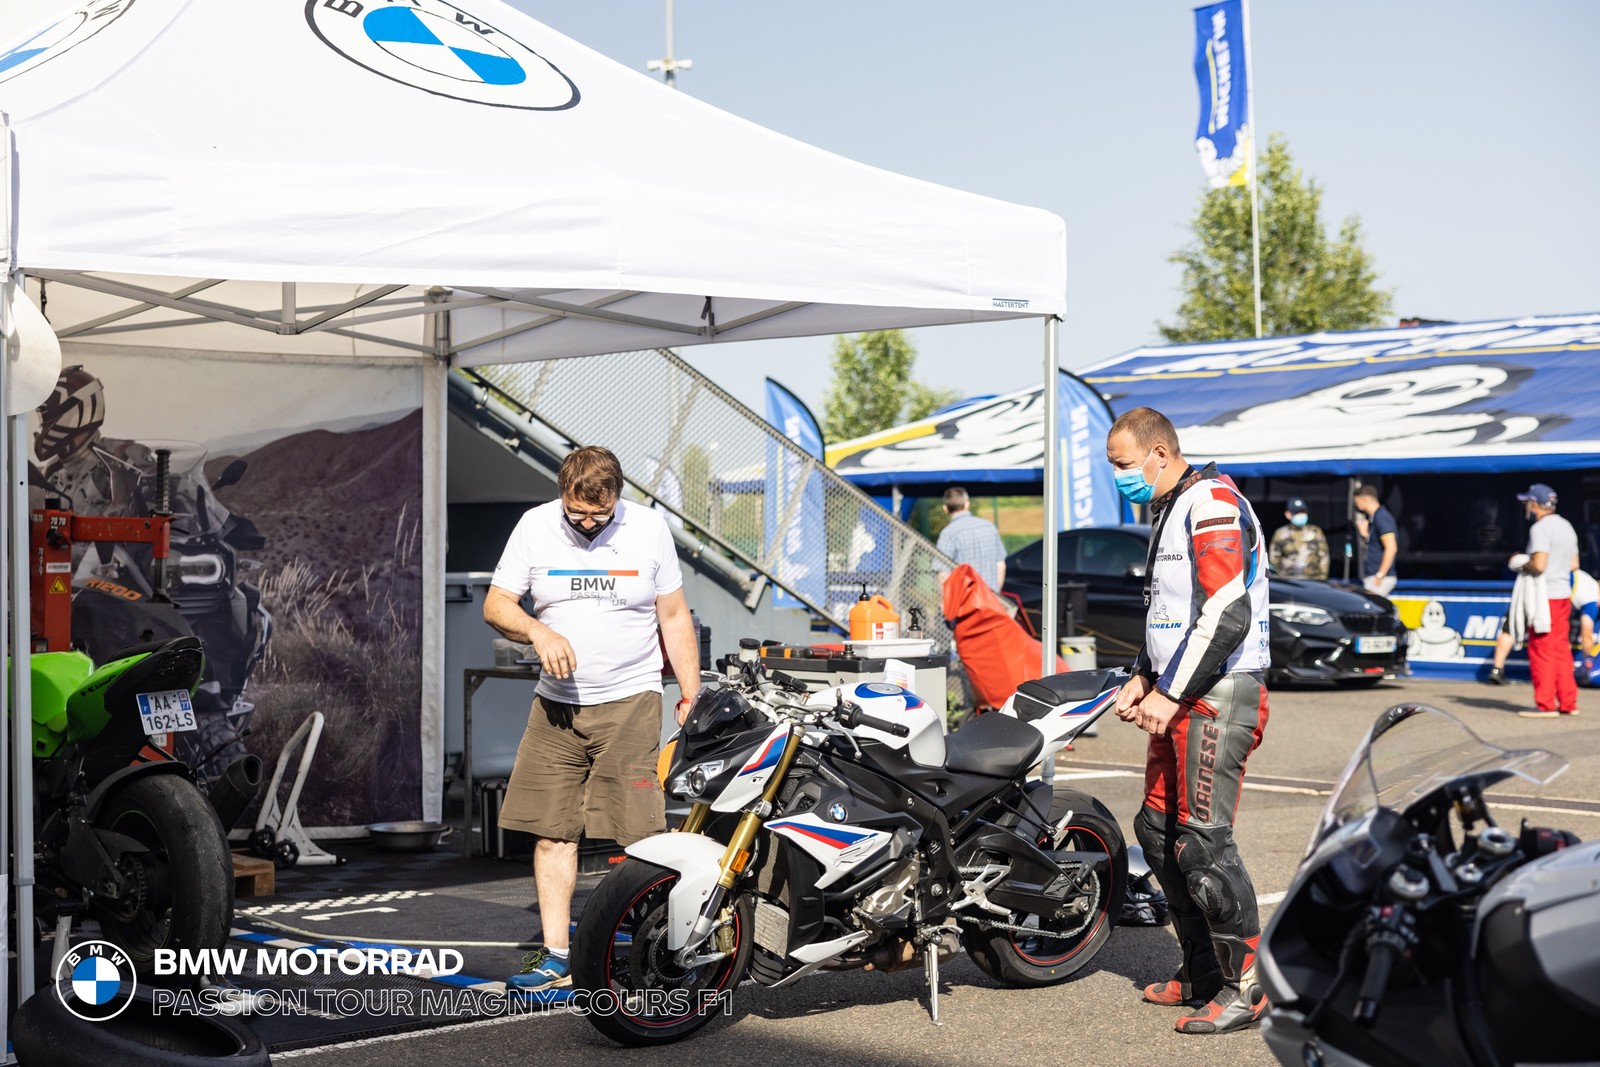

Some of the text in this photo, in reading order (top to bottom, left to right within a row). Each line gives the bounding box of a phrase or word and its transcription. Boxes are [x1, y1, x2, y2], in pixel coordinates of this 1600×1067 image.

[571, 578, 616, 591] BMW
[146, 712, 194, 730] 162-LS
[1195, 723, 1219, 823] DAINESE
